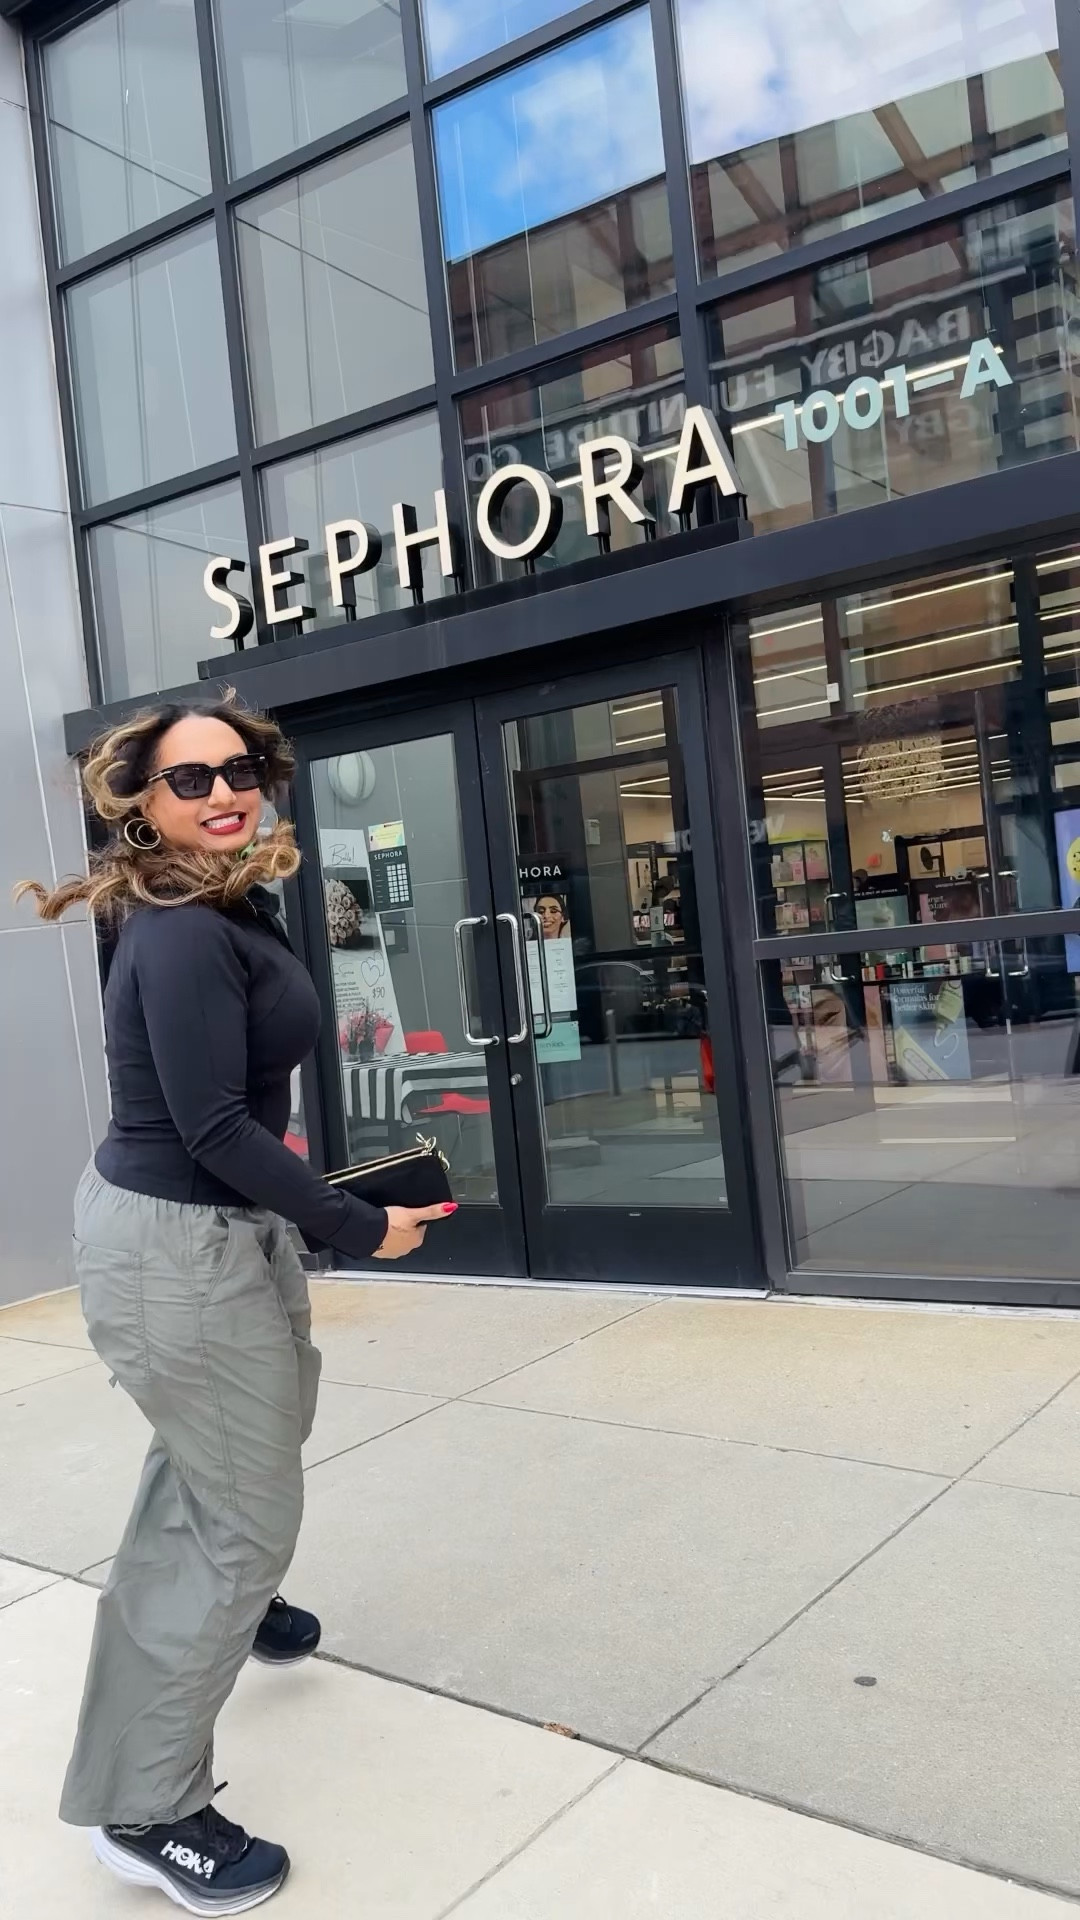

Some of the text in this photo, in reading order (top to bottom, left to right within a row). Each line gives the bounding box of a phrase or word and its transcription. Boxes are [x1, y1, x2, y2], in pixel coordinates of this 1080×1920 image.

[775, 337, 1014, 451] 1001-A
[202, 404, 742, 641] SEPHORA
[373, 850, 403, 860] SEPHORA
[519, 865, 562, 879] HORA
[918, 1001, 936, 1010] skin
[160, 1839, 216, 1880] HOKA
